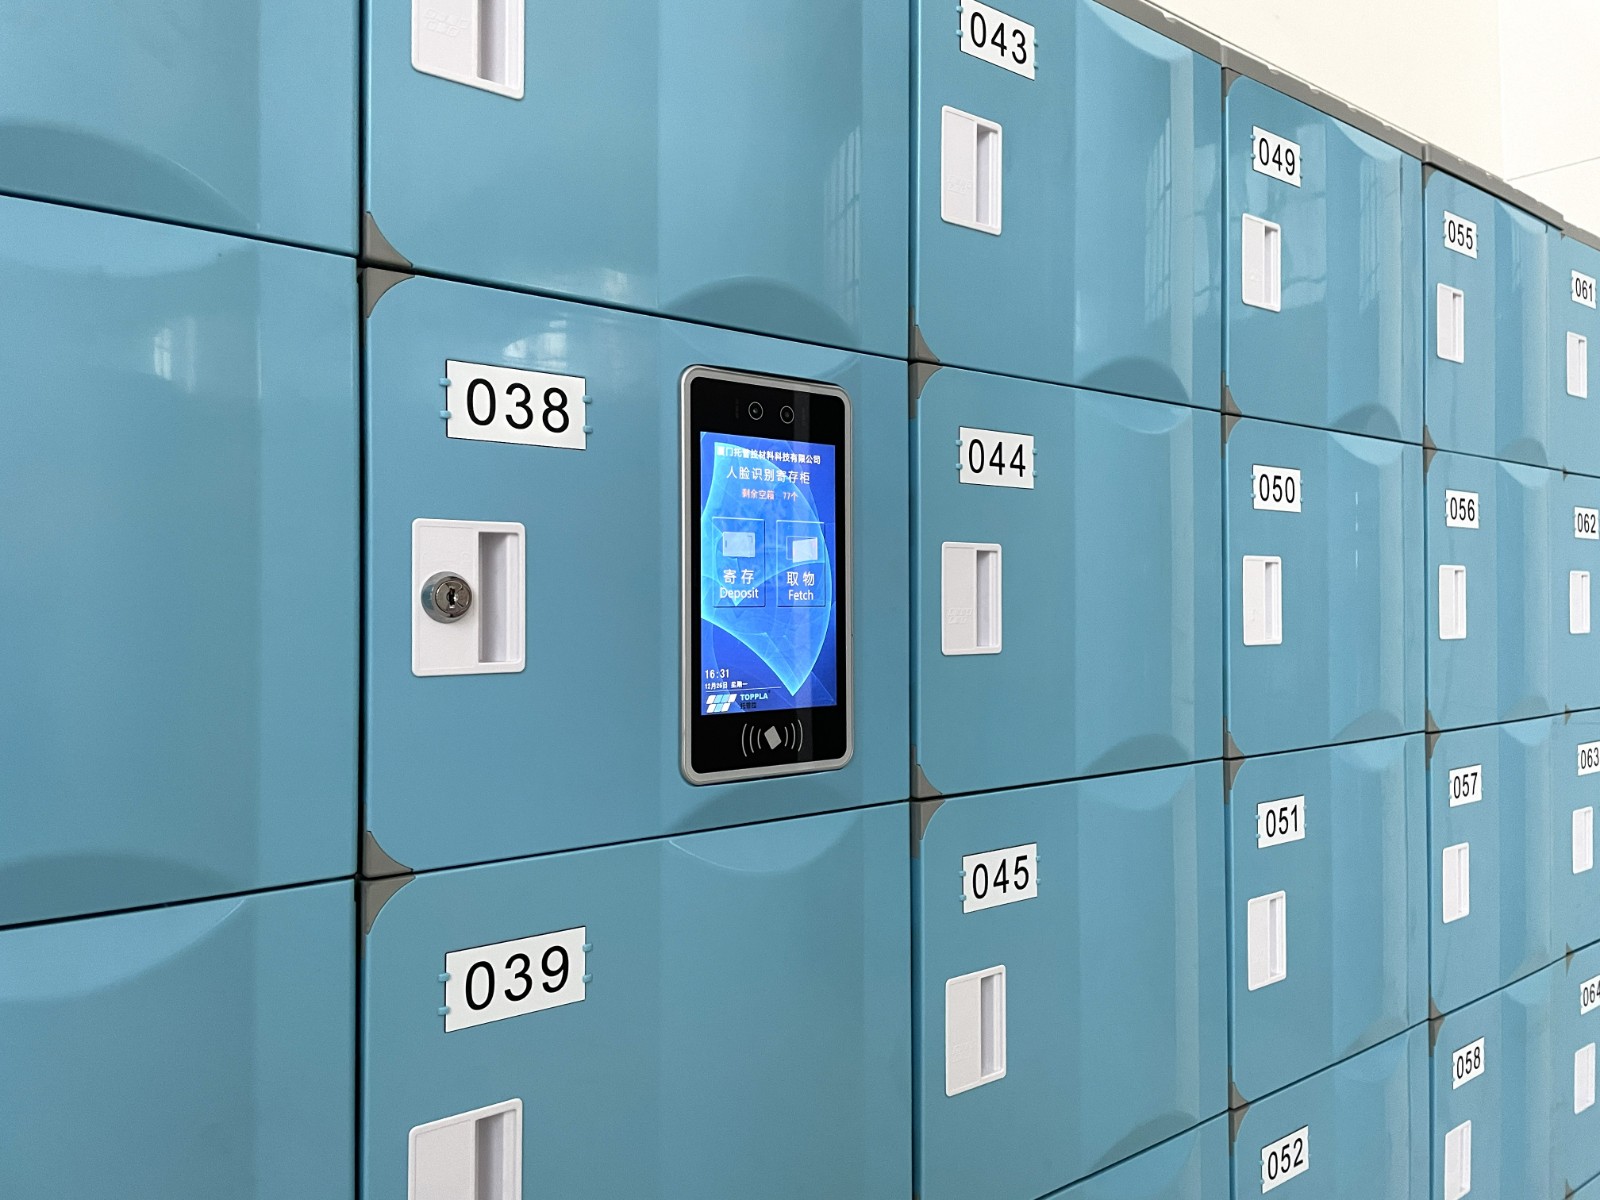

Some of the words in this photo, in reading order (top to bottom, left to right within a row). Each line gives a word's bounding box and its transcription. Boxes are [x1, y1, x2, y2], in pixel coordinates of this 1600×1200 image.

[970, 11, 1027, 65] 043
[1259, 137, 1295, 176] 049
[1448, 219, 1473, 250] 055
[1575, 278, 1593, 302] 061
[466, 378, 570, 434] 038
[968, 438, 1026, 478] 044
[726, 466, 811, 485] 人脸识别寄存柜
[1259, 473, 1295, 504] 050
[1450, 496, 1475, 522] 056
[1577, 512, 1596, 534] 062
[723, 568, 755, 585] 寄存
[786, 571, 815, 586] 取物
[720, 587, 759, 601] Deposit
[788, 589, 814, 601] Fetch
[705, 668, 730, 679] 16:31
[740, 692, 769, 701] TOPPLA
[1580, 747, 1600, 769] 063
[1453, 771, 1478, 799] 057
[1265, 804, 1298, 838] 051
[972, 854, 1030, 900] 045
[465, 945, 570, 1011] 039
[1583, 979, 1600, 1007] 064
[1456, 1046, 1481, 1080] 058
[1267, 1137, 1304, 1181] 052
